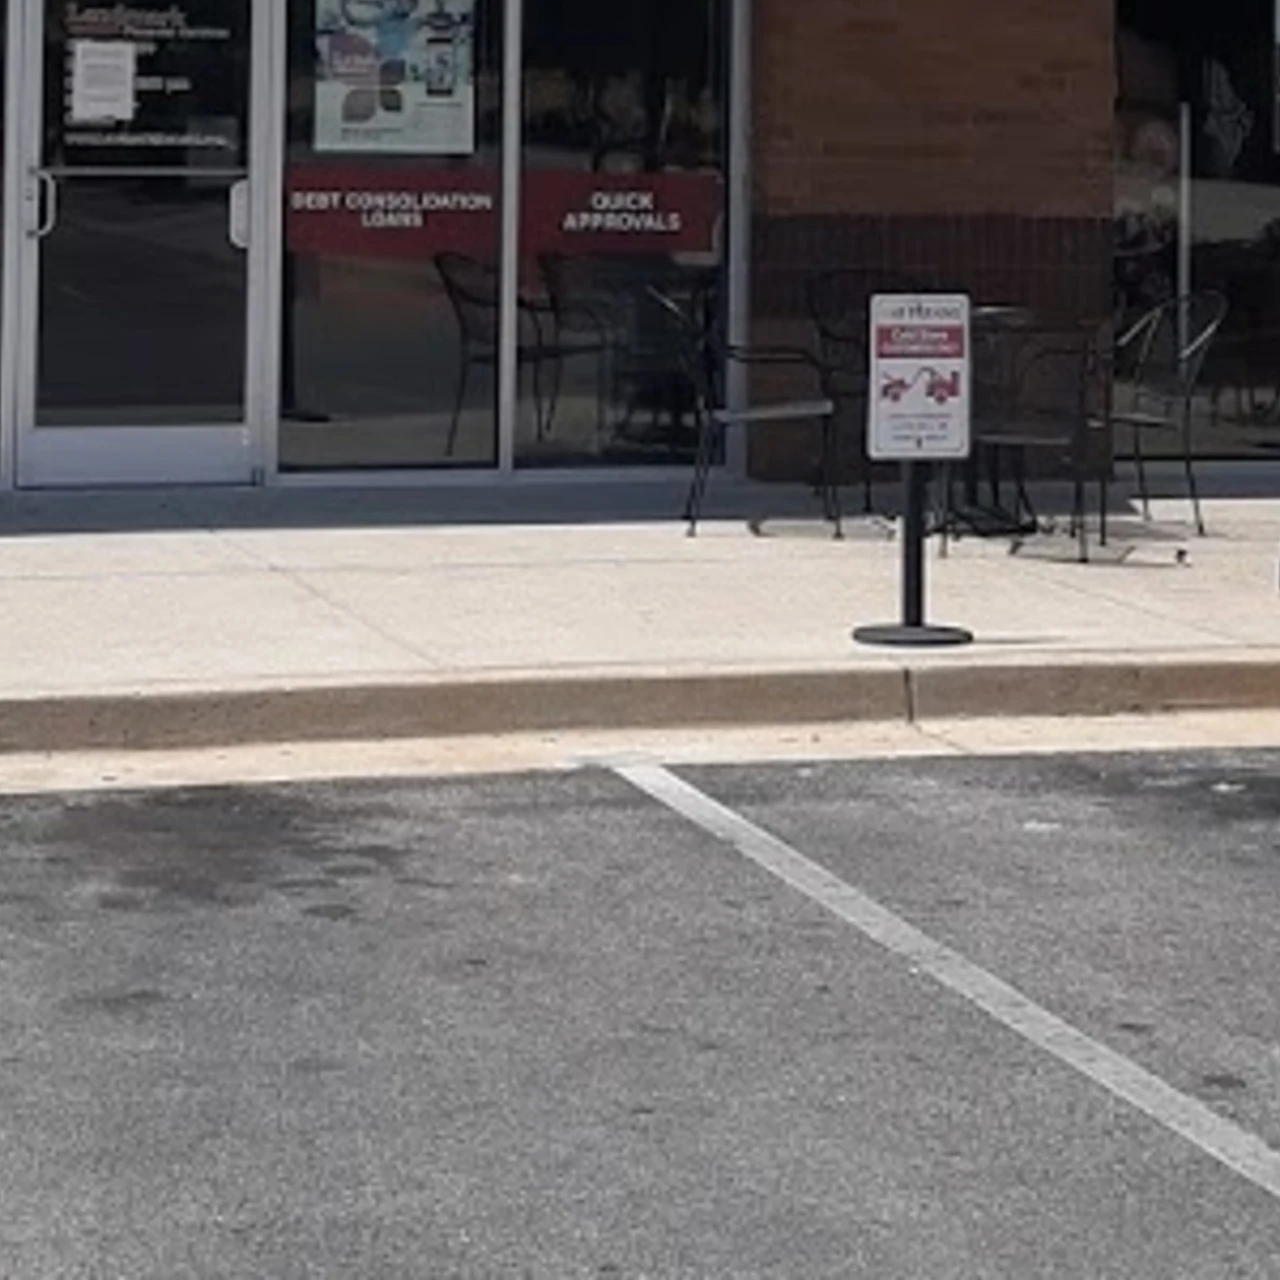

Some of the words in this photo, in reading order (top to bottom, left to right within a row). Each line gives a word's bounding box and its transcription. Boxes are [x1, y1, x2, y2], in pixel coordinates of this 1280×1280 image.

[291, 191, 342, 210] DEBT
[345, 192, 493, 210] CONSOLIDATION
[591, 192, 654, 210] QUICK
[361, 213, 424, 228] LOANS
[562, 212, 682, 231] APPROVALS
